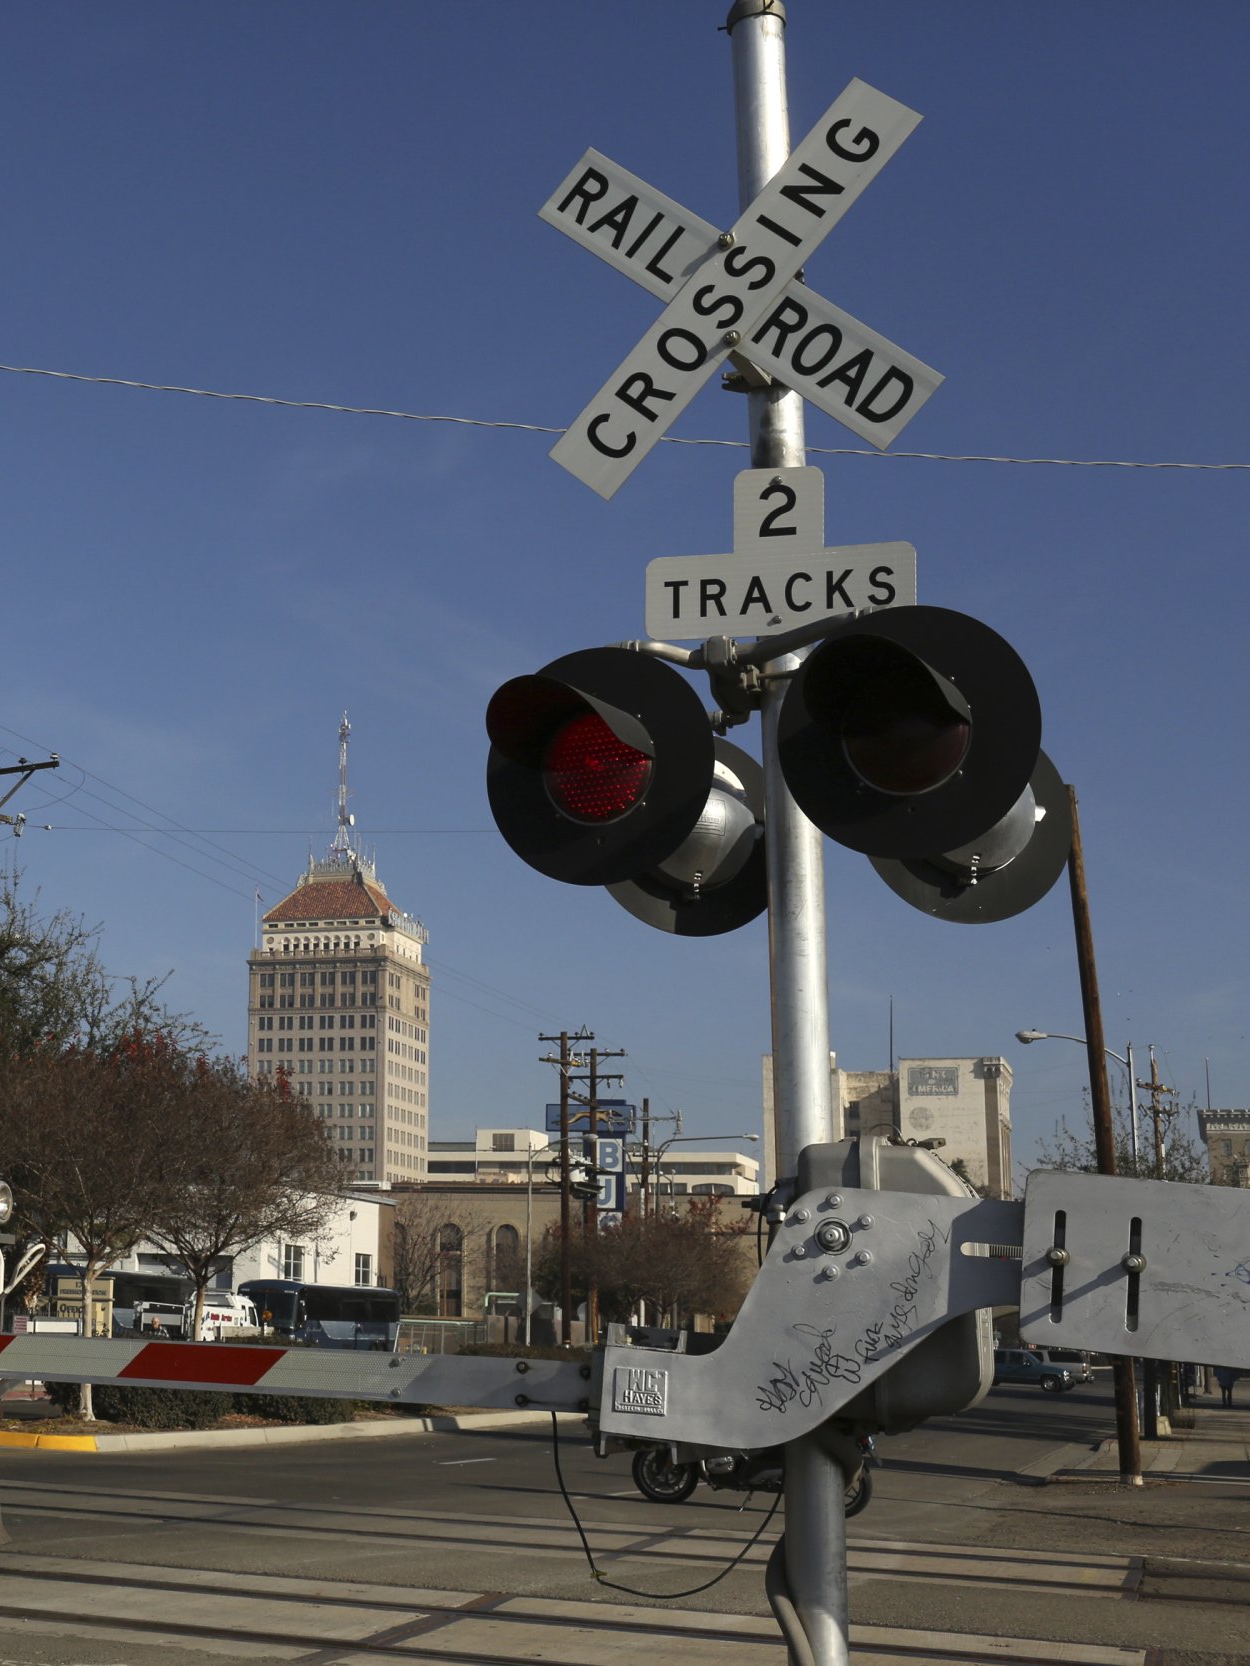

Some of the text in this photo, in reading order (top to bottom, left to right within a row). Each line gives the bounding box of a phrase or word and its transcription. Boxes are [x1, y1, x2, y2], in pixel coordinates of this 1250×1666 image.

[556, 166, 687, 285] RAIL
[587, 118, 881, 459] CROSSING
[750, 295, 915, 424] ROAD
[758, 484, 797, 538] 2
[663, 565, 897, 619] TRACKS
[622, 1389, 663, 1406] HAYES
